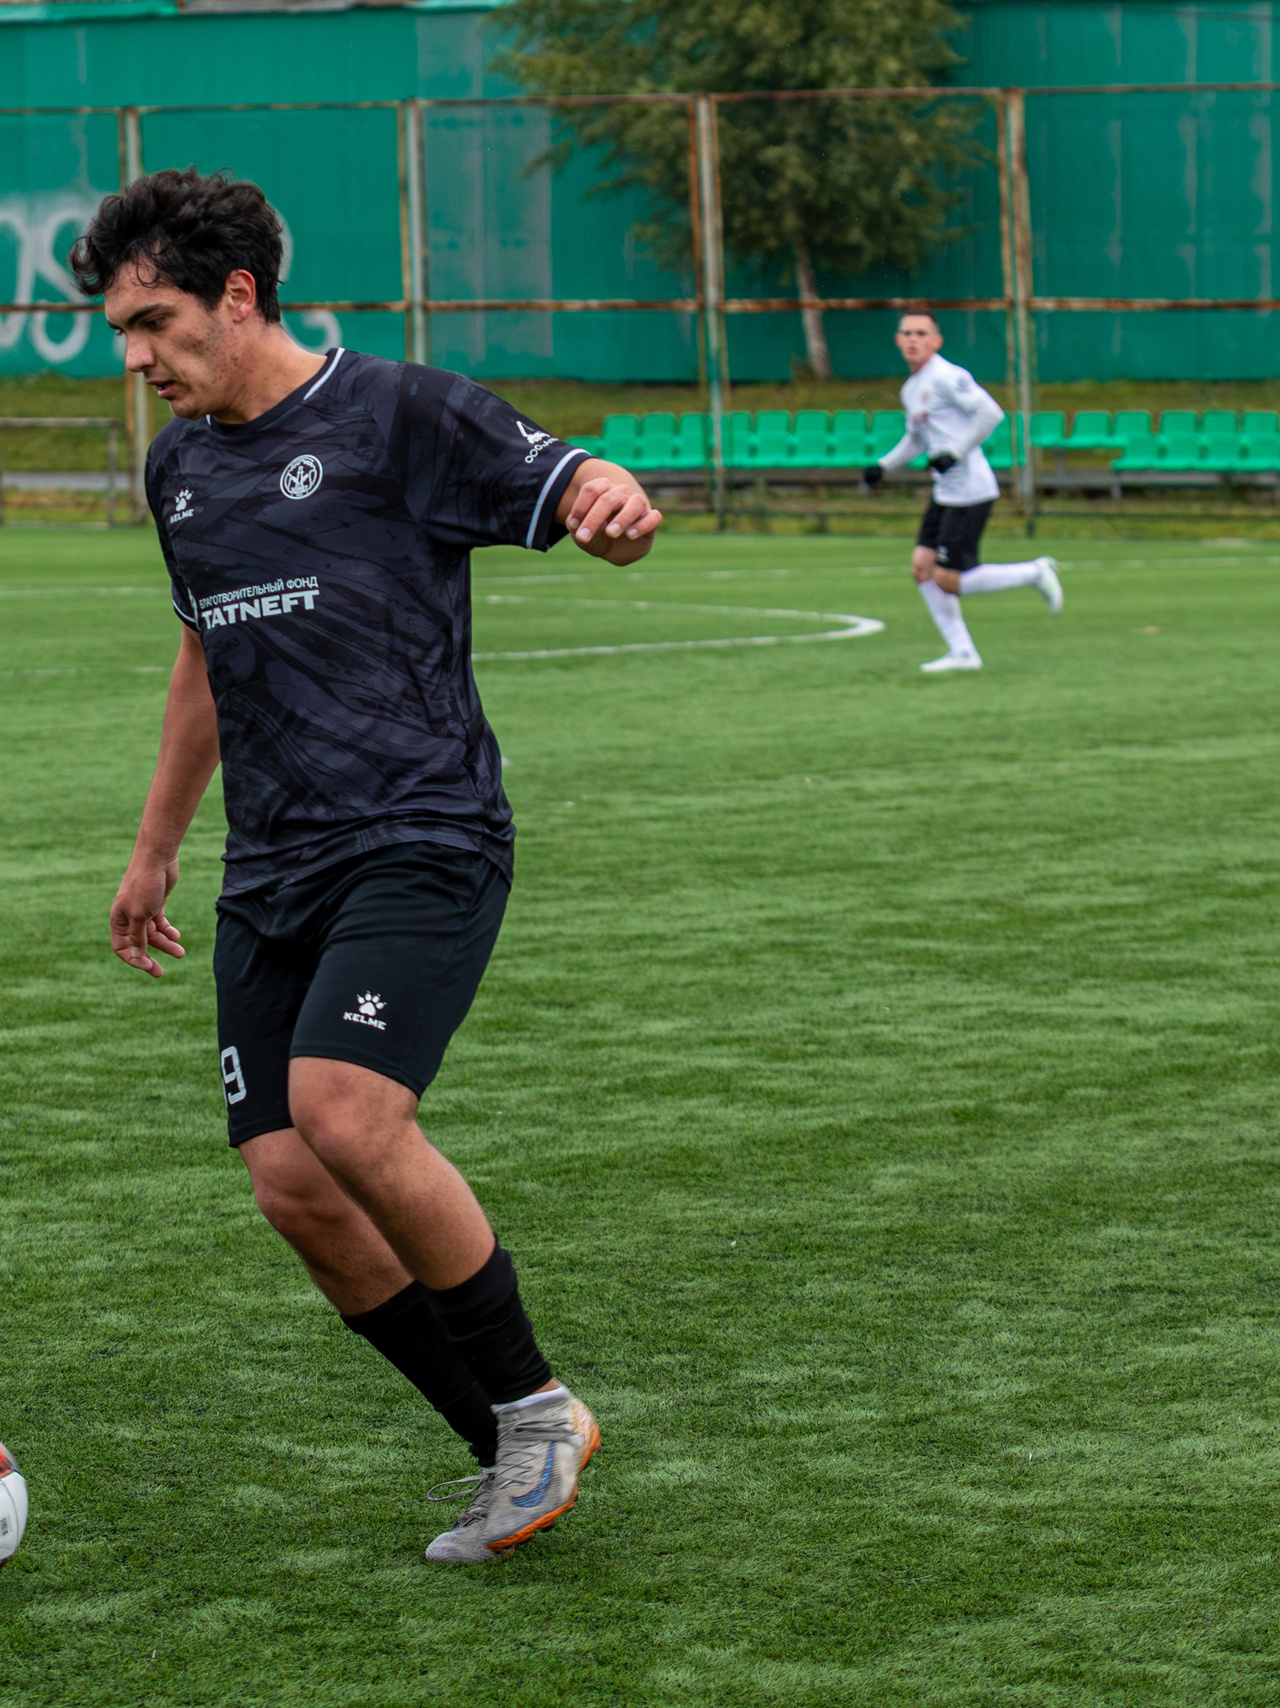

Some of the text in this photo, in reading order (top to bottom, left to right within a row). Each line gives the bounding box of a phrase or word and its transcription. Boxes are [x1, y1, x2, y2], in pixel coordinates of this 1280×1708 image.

[169, 508, 194, 524] KELME
[199, 575, 319, 610] БЛАГОТВОРИТЕЛЬНЫЙ ФОНД
[201, 589, 320, 630] TATNEFT
[342, 1010, 388, 1031] KELME
